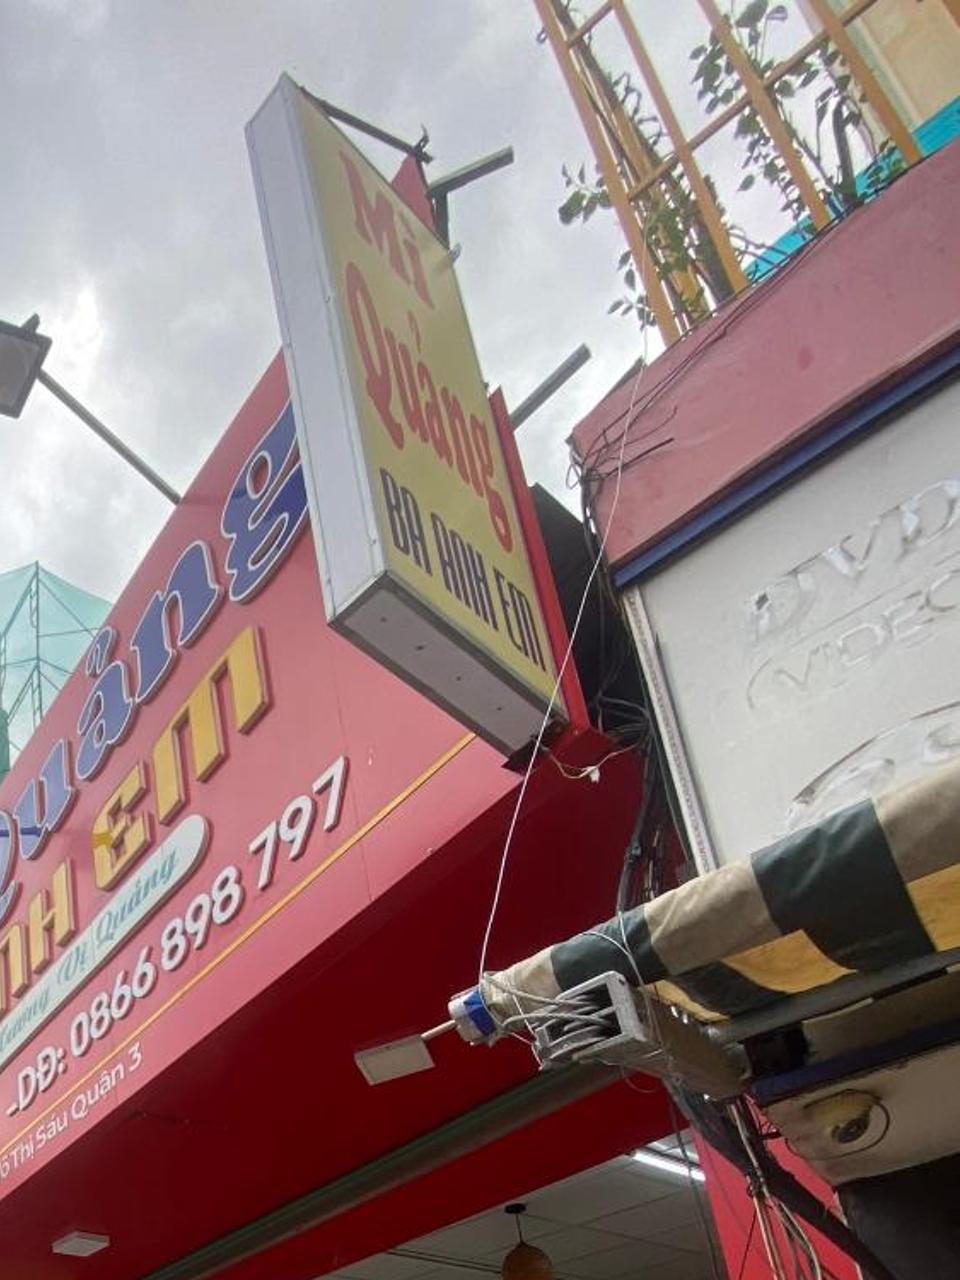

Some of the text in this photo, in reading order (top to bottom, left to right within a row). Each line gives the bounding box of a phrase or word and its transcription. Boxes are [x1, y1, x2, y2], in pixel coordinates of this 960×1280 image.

[338, 150, 435, 310] Mì
[346, 261, 513, 554] Quảng
[380, 467, 547, 673] BA ANH EM
[92, 625, 274, 892] EM
[70, 946, 158, 1058] 0866
[160, 865, 244, 972] 898
[248, 754, 350, 892] 797
[35, 1110, 69, 1149] Sáu
[128, 1041, 142, 1071] 3
